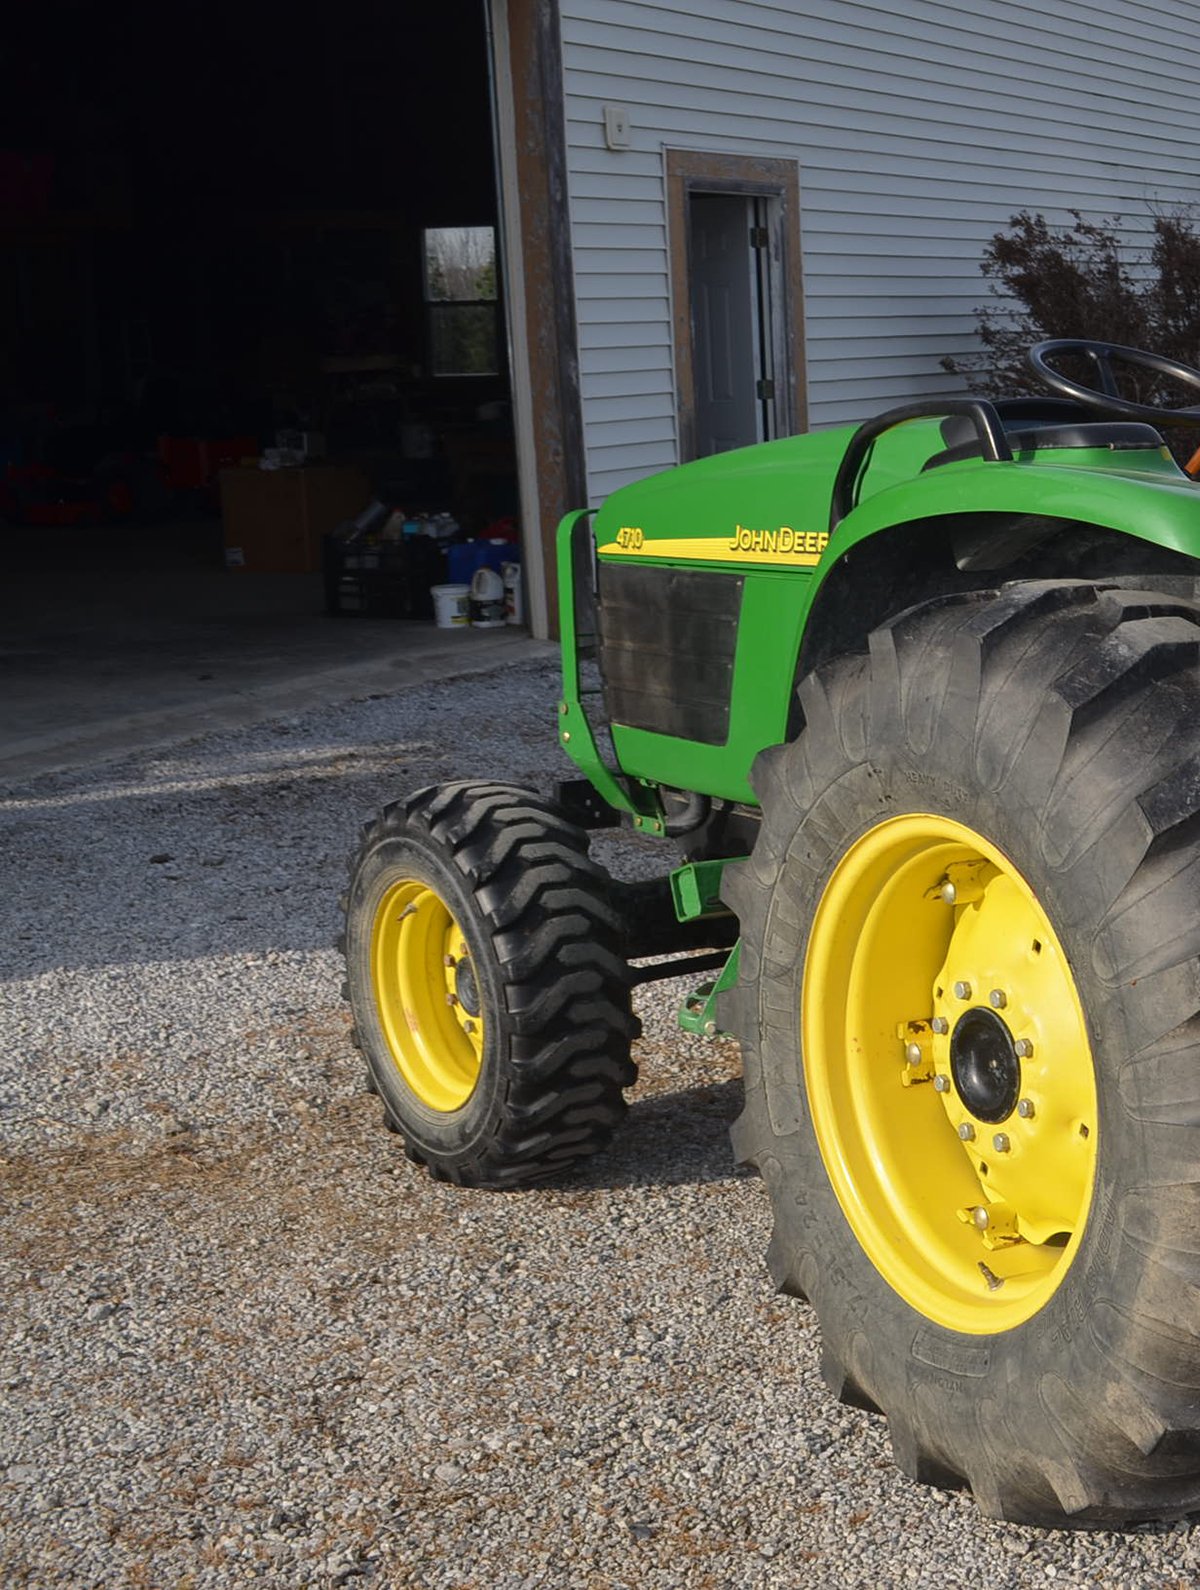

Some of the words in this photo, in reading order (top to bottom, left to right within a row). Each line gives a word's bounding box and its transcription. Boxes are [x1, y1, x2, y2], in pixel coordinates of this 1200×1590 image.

[616, 527, 643, 549] 4710
[729, 524, 778, 552] JOHN
[779, 526, 830, 555] DEER
